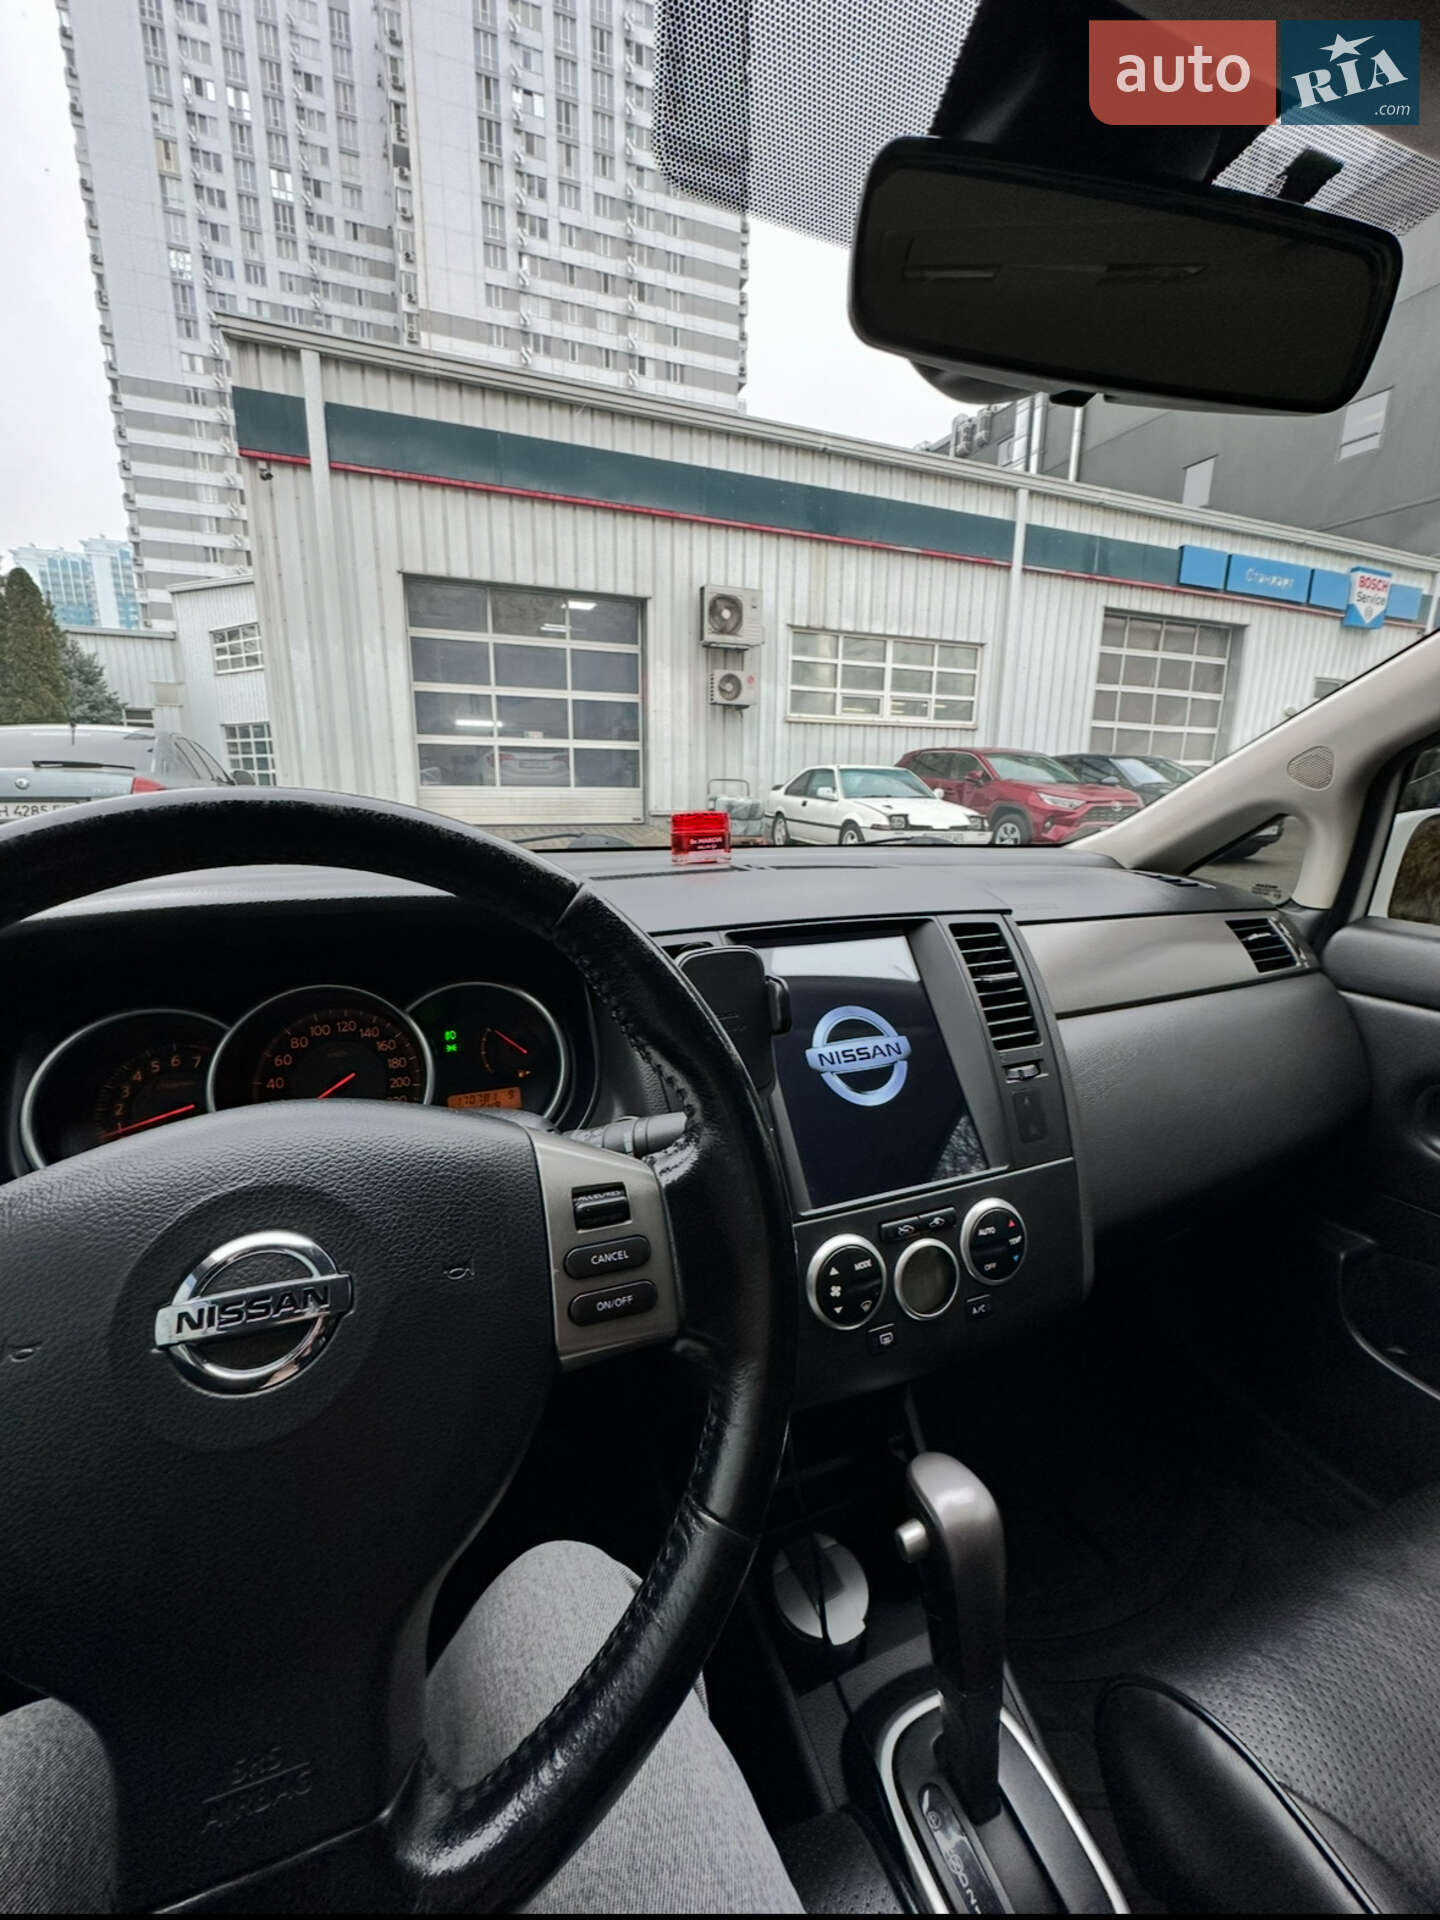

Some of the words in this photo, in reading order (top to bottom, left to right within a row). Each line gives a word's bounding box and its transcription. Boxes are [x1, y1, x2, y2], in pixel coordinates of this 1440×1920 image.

[1358, 575, 1390, 593] BOSCH
[1356, 591, 1386, 606] Service
[310, 1024, 331, 1036] 100
[336, 1020, 357, 1033] 120
[360, 1026, 380, 1038] 140
[290, 1036, 309, 1049] 80
[376, 1039, 397, 1051] 160
[170, 1055, 181, 1067] 6
[274, 1053, 292, 1066] 60
[817, 1042, 903, 1067] NISSAN
[151, 1060, 161, 1073] 5
[192, 1056, 202, 1069] 7
[387, 1057, 407, 1069] 180
[132, 1070, 142, 1081] 4
[389, 1076, 411, 1088] 200
[266, 1077, 285, 1089] 40
[122, 1085, 131, 1098] 3
[114, 1103, 124, 1116] 2
[977, 1226, 996, 1237] AUTO
[590, 1250, 630, 1266] CANCEL
[853, 1258, 872, 1271] MODE
[984, 1262, 998, 1272] OFF
[176, 1284, 331, 1336] NISSAN
[596, 1295, 634, 1312] ON/OFF
[971, 1303, 987, 1315] A/C
